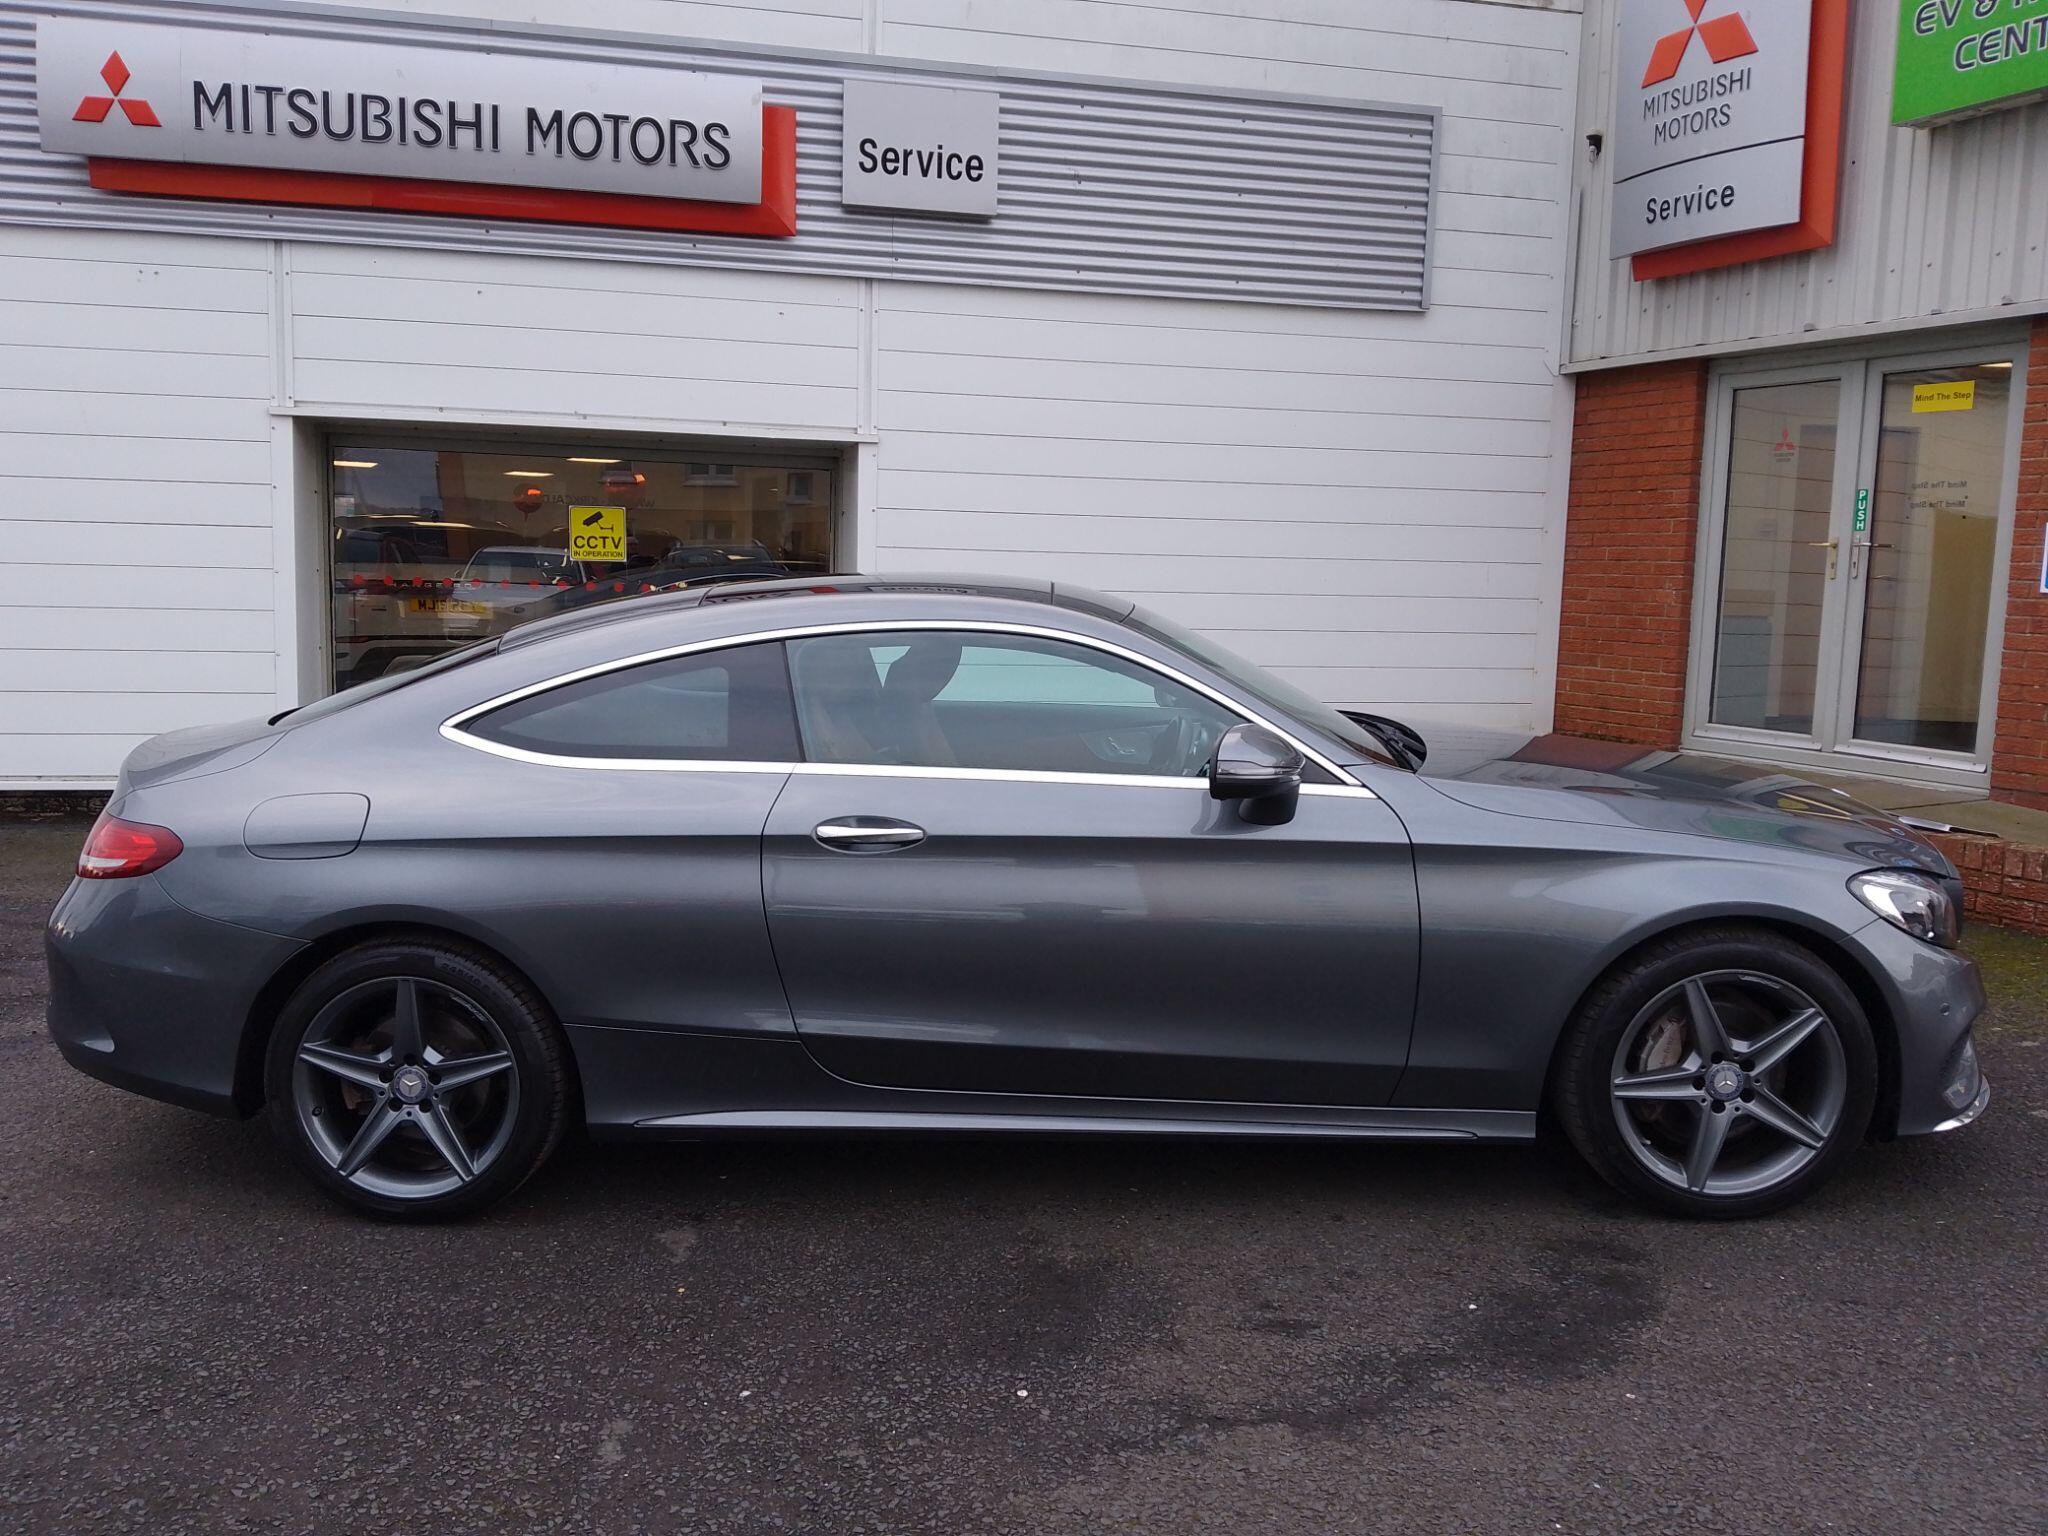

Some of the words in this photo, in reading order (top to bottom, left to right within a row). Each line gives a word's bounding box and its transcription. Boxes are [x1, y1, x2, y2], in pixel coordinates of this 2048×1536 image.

[1914, 0, 1961, 35] EV
[1643, 67, 1751, 120] MITSUBISHI
[193, 80, 500, 153] MITSUBISHI
[526, 106, 732, 170] MOTORS
[1654, 103, 1731, 145] MOTORS
[858, 138, 984, 182] Service
[1646, 183, 1735, 224] Service
[1937, 393, 1952, 401] The
[1953, 391, 1972, 400] Step
[1855, 490, 1867, 530] PUSH
[573, 535, 622, 550] CCTV
[582, 550, 624, 558] OPERATION
